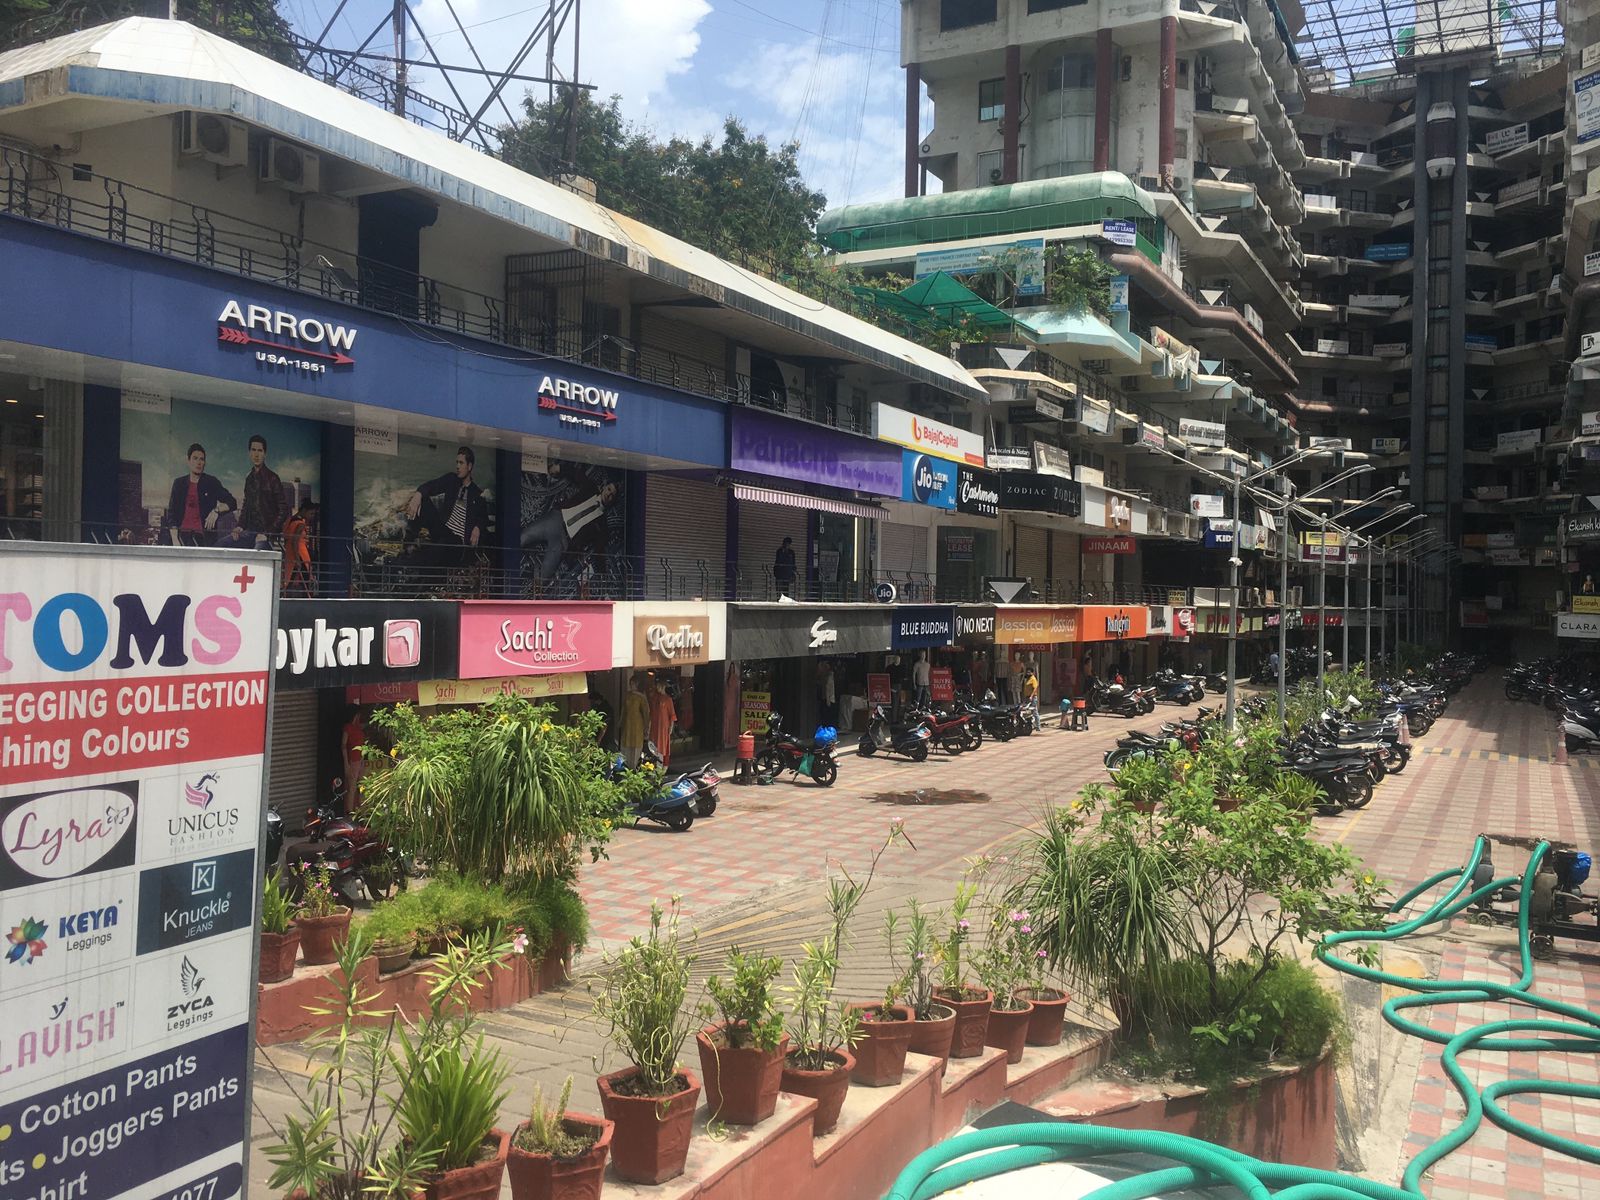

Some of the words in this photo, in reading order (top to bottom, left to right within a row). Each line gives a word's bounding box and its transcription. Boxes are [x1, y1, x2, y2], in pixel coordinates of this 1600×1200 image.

[218, 300, 357, 351] ARROW
[255, 351, 326, 373] USA-1851
[538, 376, 619, 410] ARROW
[355, 426, 389, 438] ARROW
[923, 426, 959, 449] BajajCapital
[917, 466, 932, 489] Jio
[962, 471, 973, 481] THE
[960, 481, 999, 504] Cashmere
[1007, 486, 1047, 496] ZODIAC
[978, 503, 999, 515] STORE
[1568, 520, 1594, 531] Ekansh
[947, 543, 973, 553] LEASE
[1088, 541, 1129, 551] JINAAM
[878, 588, 892, 599] Jio
[900, 621, 919, 636] BLUE
[920, 620, 949, 635] BUDDHA
[963, 617, 975, 634] NO
[975, 617, 994, 633] NEXT
[999, 618, 1044, 632] Jessica
[1050, 613, 1075, 633] Jessica
[1560, 622, 1598, 631] CLARA
[501, 616, 554, 652] Sachi
[646, 624, 704, 659] Radha
[533, 650, 578, 663] Collection
[376, 682, 401, 695] Sachi
[434, 683, 457, 698] Sachi
[0, 688, 107, 725] EGGING
[116, 679, 265, 716] COLLECTION
[744, 711, 768, 719] SALE
[2, 734, 71, 770] hing
[82, 725, 190, 758] Colours
[168, 808, 239, 836] UNICUS
[10, 812, 111, 865] Lyra
[58, 905, 118, 938] KEYA
[163, 897, 230, 932] Knuckle
[185, 921, 213, 939] JEANS
[66, 932, 112, 951] Leggings
[167, 995, 214, 1019] ZYCA
[167, 1009, 214, 1032] Leggings
[20, 1082, 117, 1133] Cotton
[126, 1054, 197, 1096] Pants
[0, 1159, 26, 1186] ts
[53, 1106, 164, 1165] Joggers
[172, 1077, 239, 1117] Pants
[26, 1170, 89, 1200] hirt
